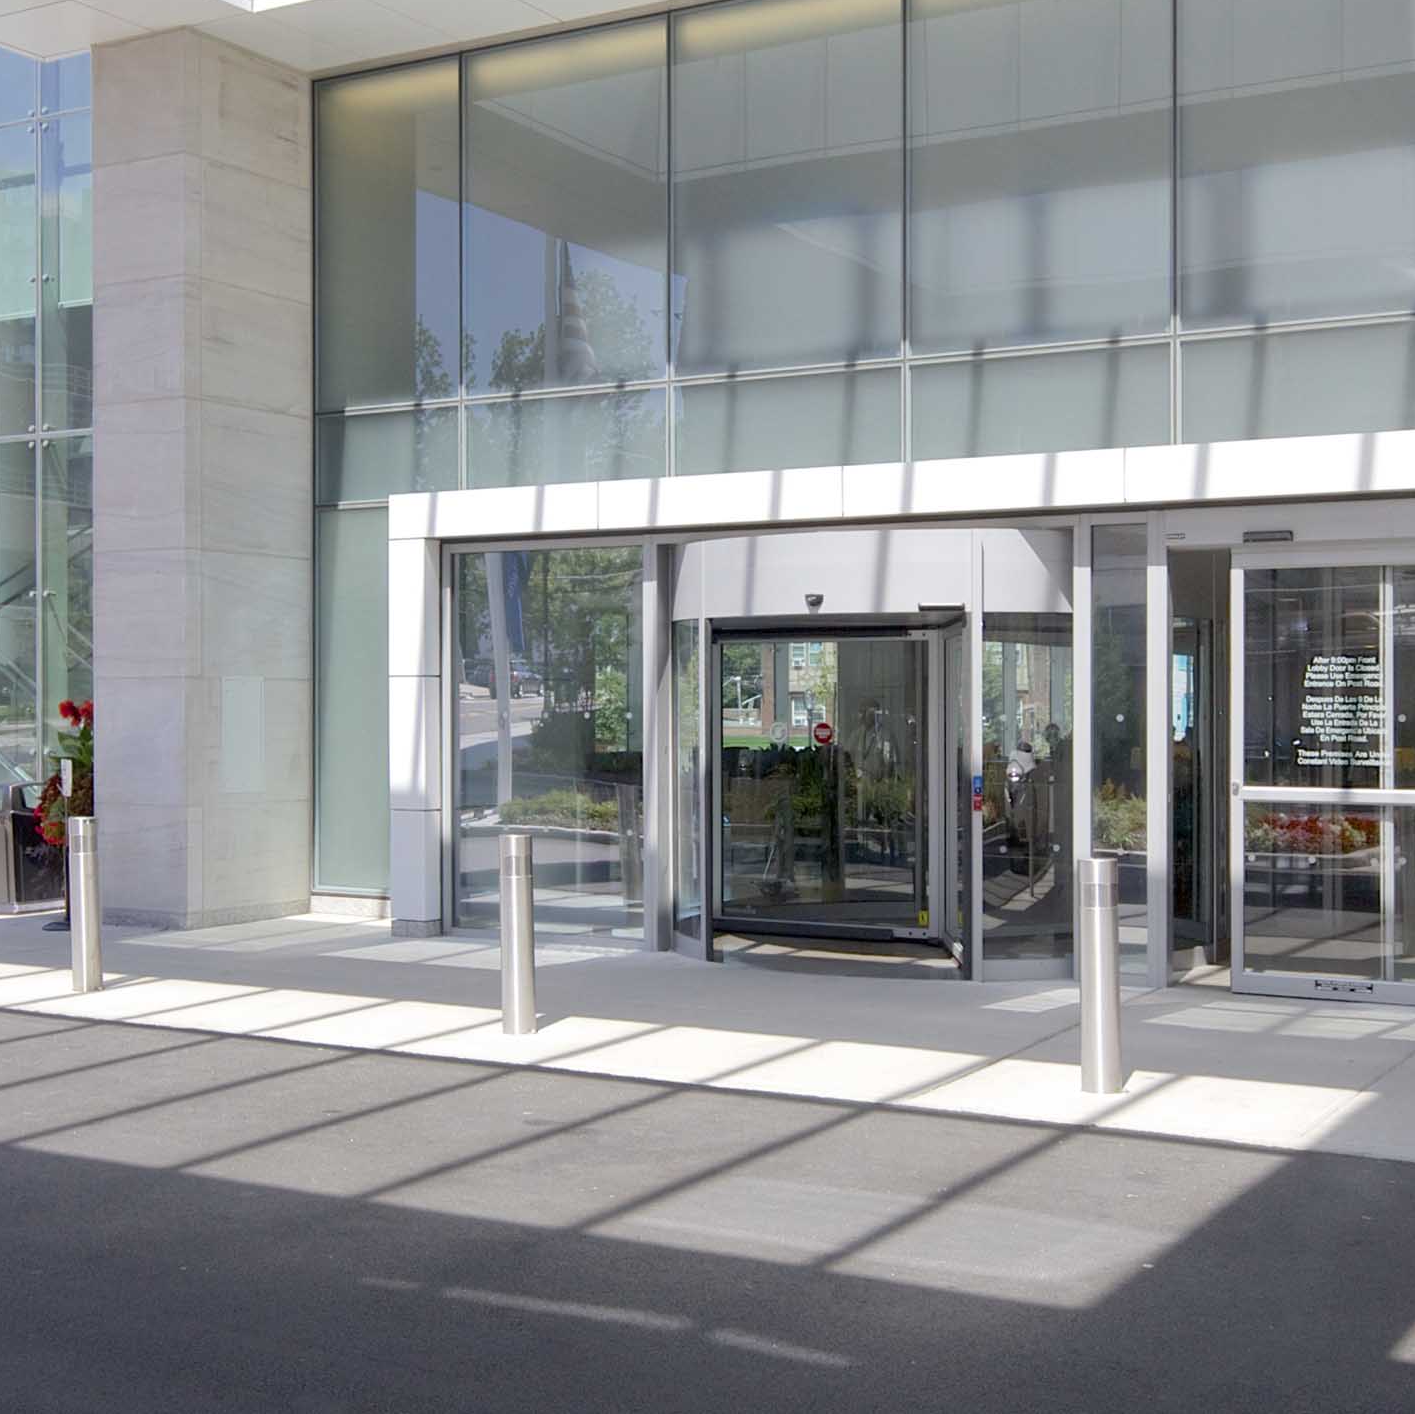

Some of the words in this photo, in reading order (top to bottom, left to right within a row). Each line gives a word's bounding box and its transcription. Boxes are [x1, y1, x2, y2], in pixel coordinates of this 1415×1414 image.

[1313, 656, 1330, 664] After
[1358, 656, 1376, 664] Front
[1307, 665, 1327, 673] Lobby
[1330, 665, 1346, 673] Door
[1297, 749, 1319, 757] These
[1321, 749, 1353, 757] Premises
[1354, 749, 1367, 757] Are
[1297, 757, 1326, 765] Constant
[1328, 757, 1348, 765] Video
